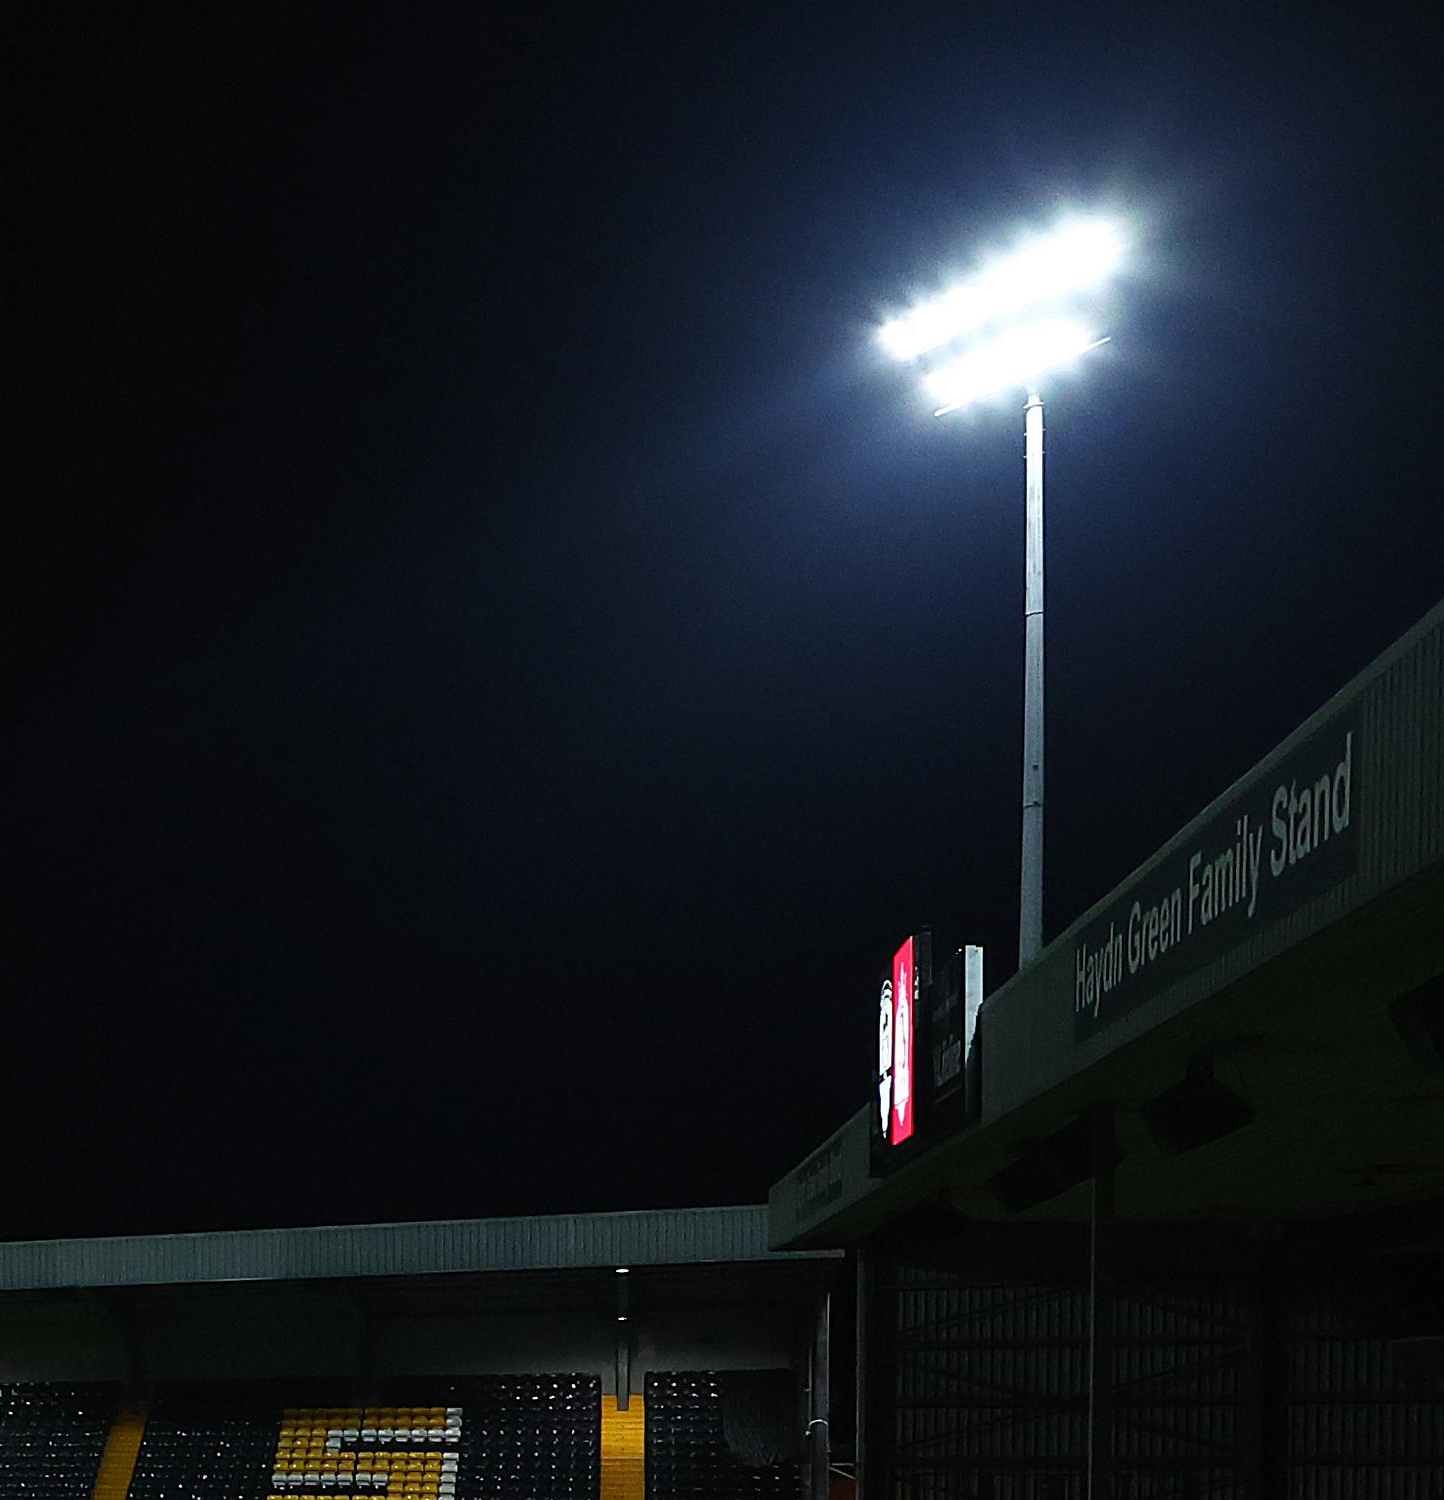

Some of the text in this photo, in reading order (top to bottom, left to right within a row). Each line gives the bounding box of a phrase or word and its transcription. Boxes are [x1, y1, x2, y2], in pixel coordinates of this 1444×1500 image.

[1075, 730, 1354, 1018] Haydn Green Family Stand
